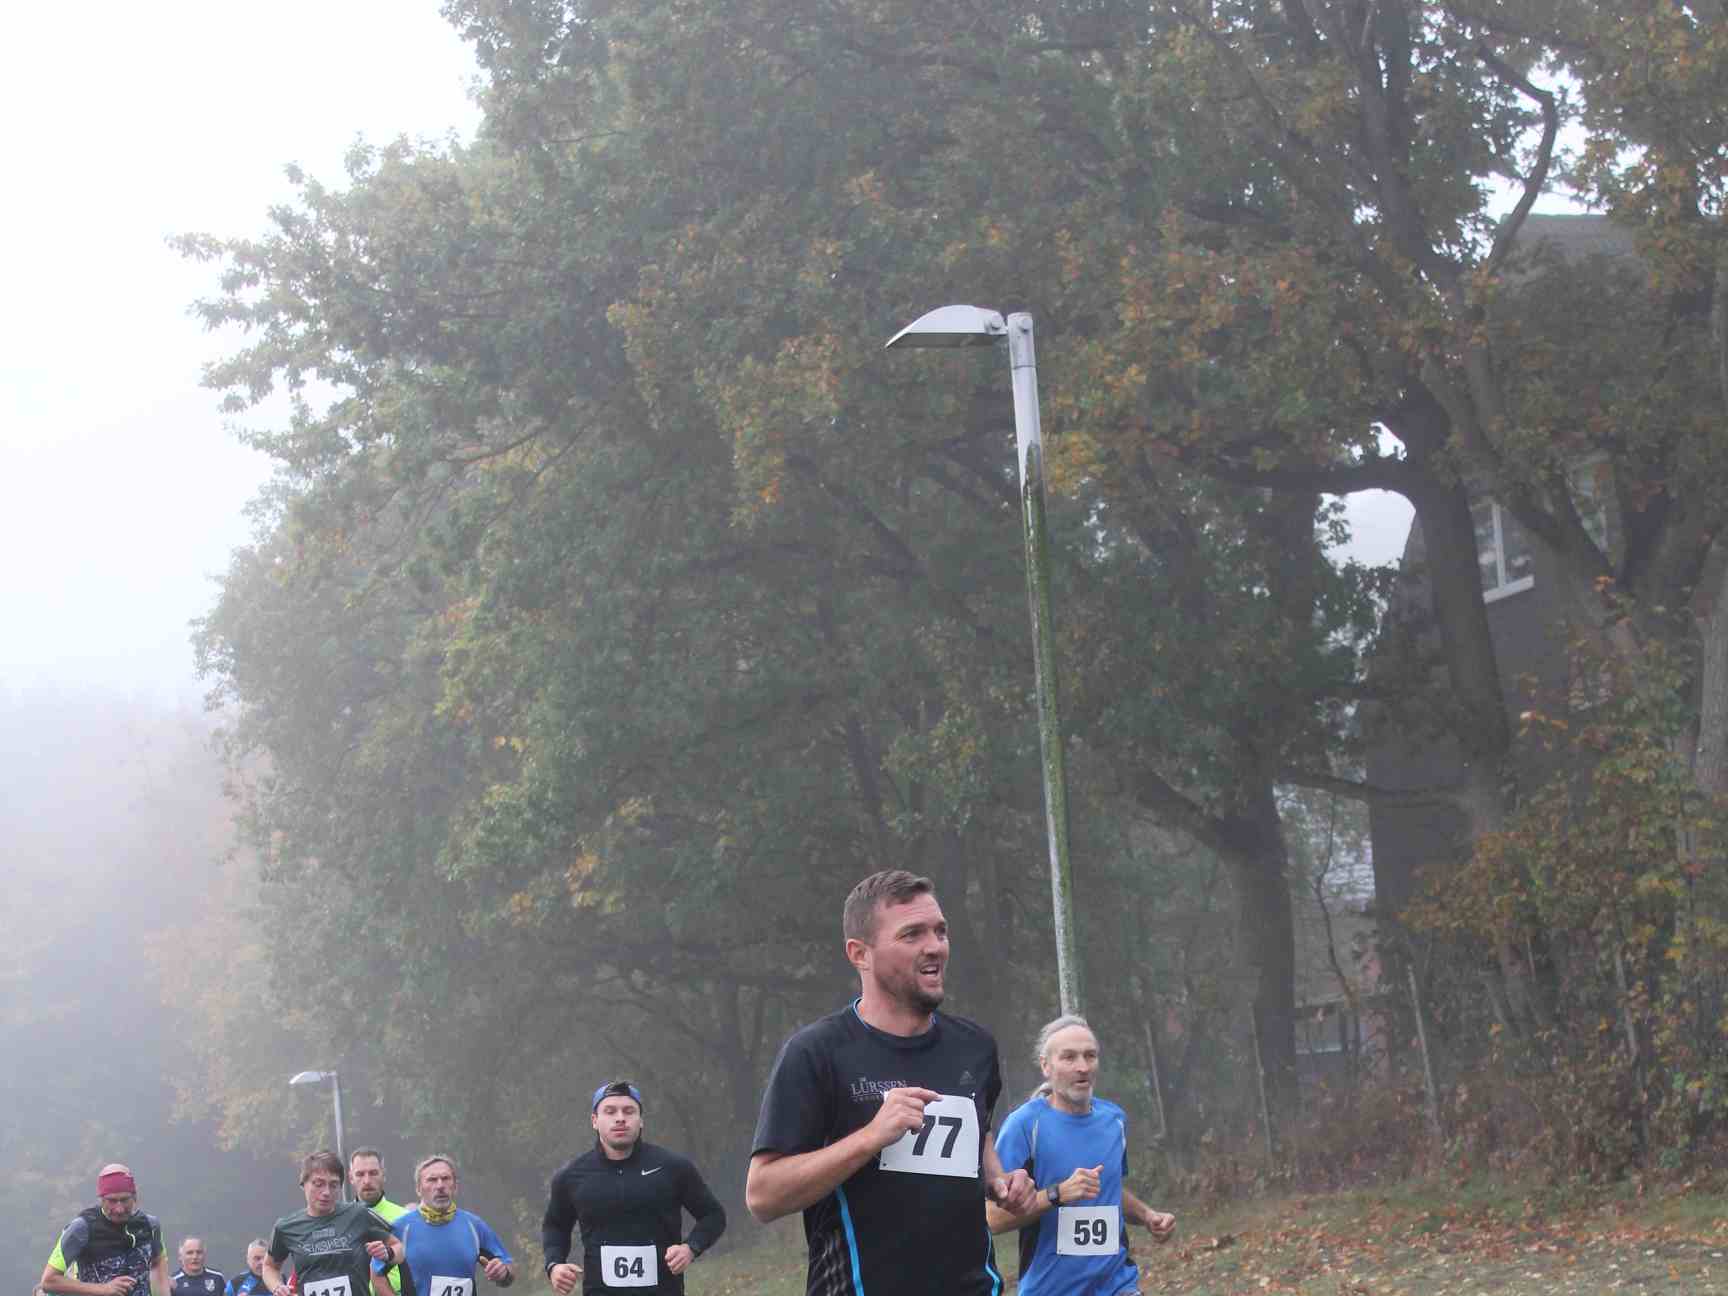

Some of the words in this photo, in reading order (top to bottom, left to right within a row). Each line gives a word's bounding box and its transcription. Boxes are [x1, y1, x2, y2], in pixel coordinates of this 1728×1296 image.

[912, 1114, 963, 1159] 77
[1073, 1218, 1108, 1246] 59
[614, 1256, 645, 1279] 64
